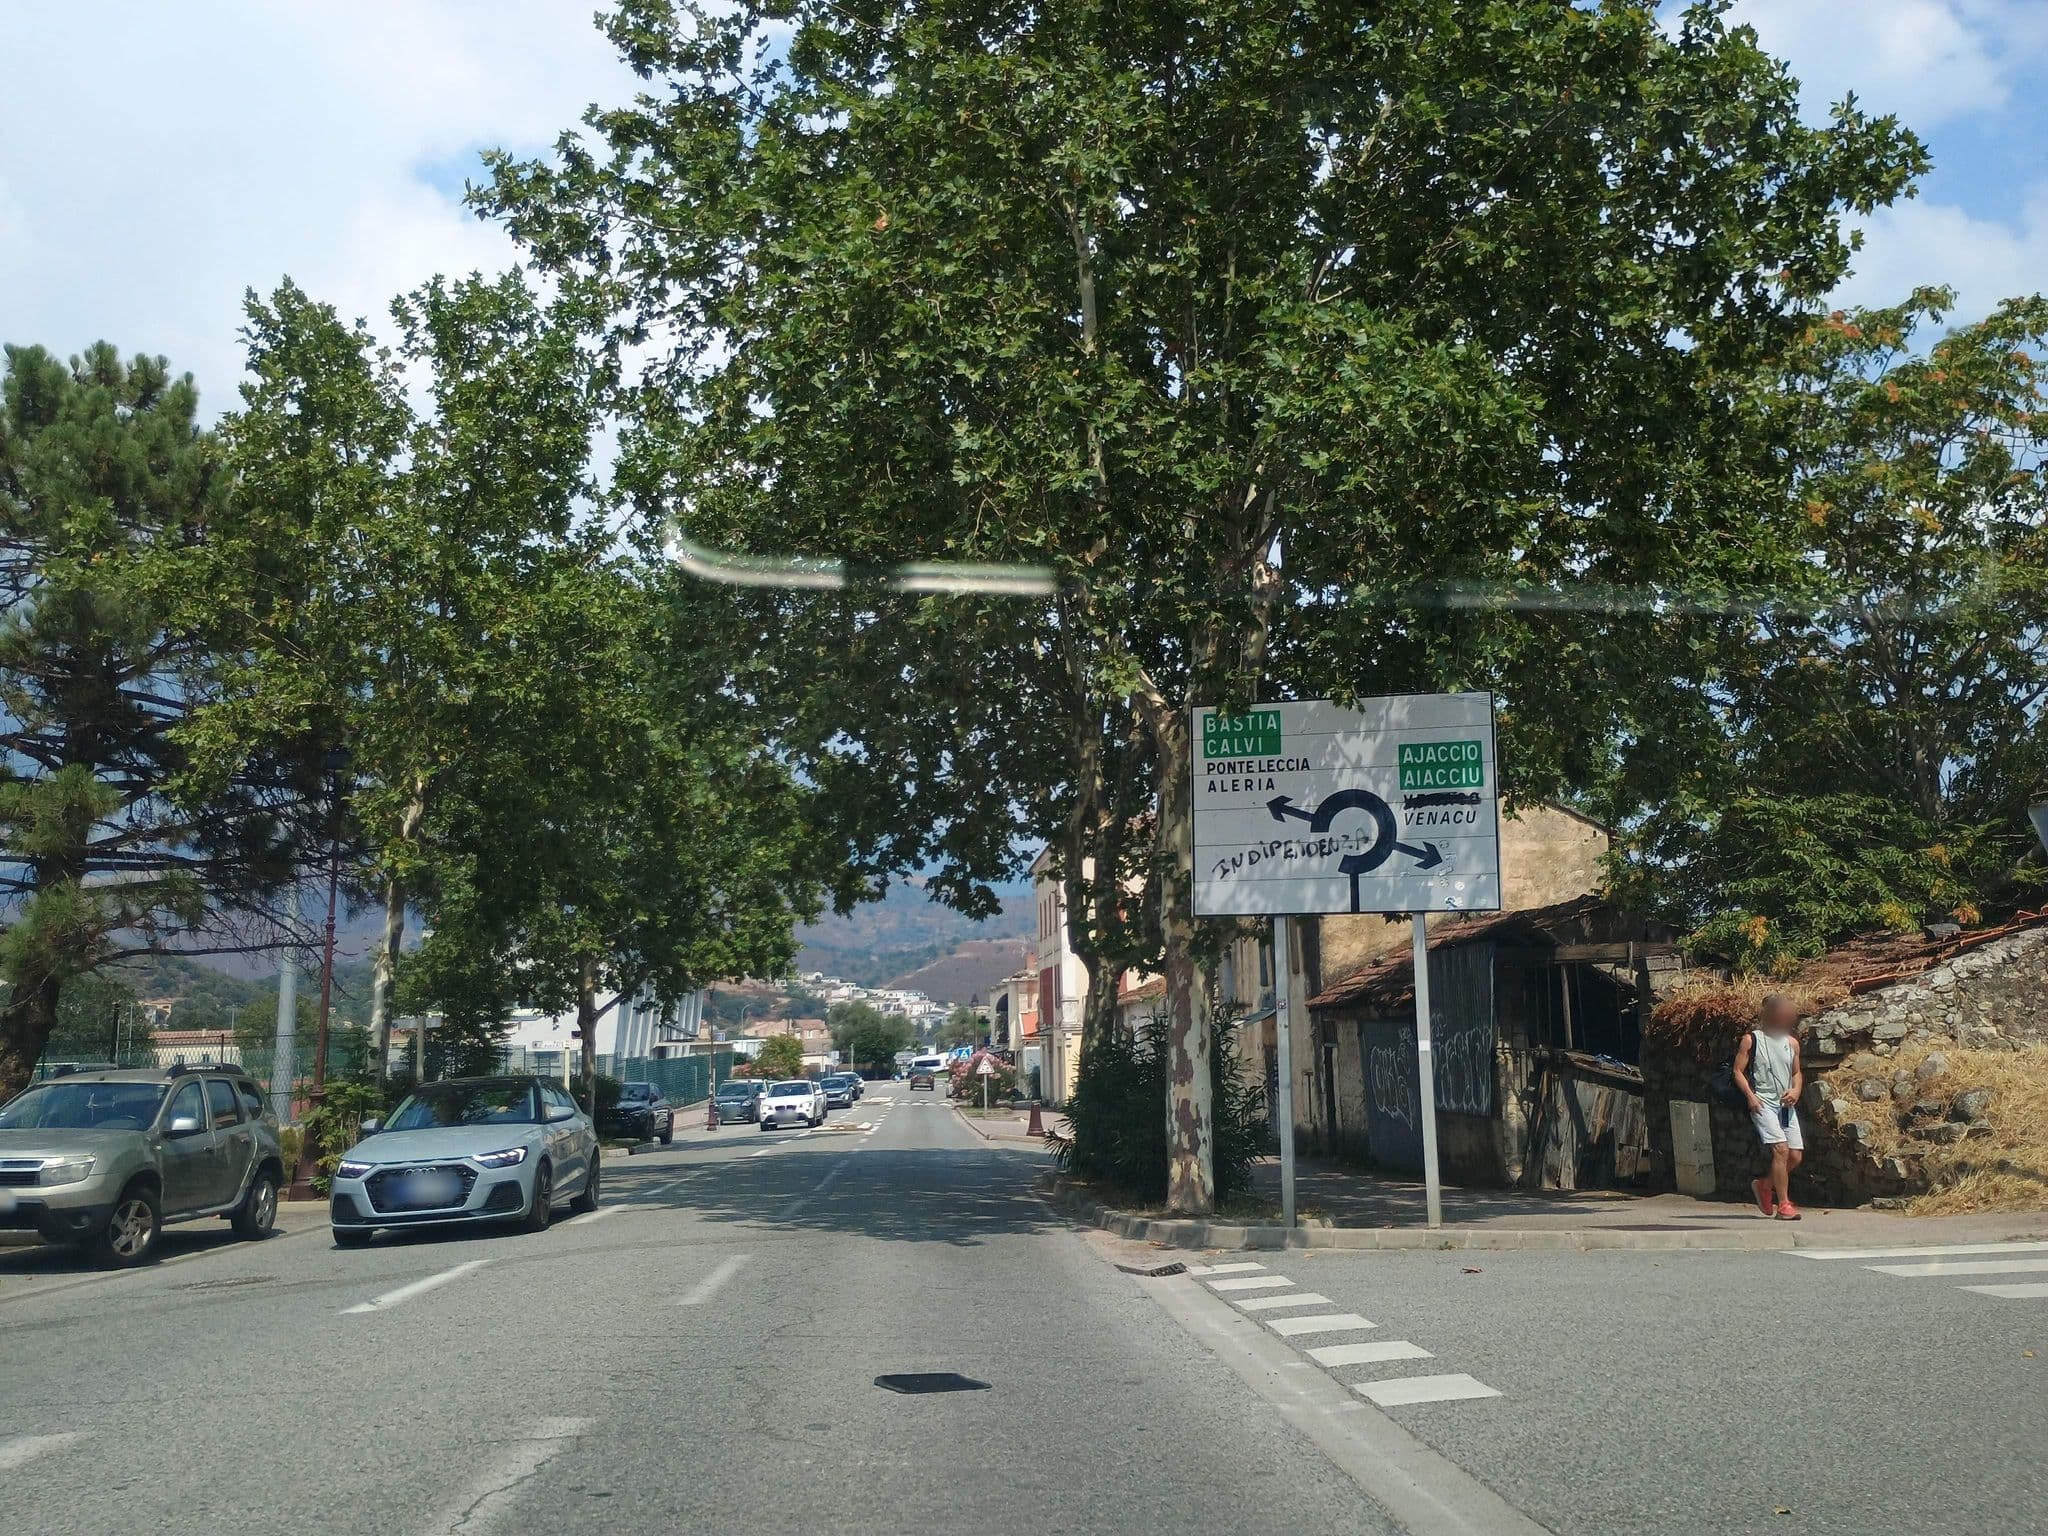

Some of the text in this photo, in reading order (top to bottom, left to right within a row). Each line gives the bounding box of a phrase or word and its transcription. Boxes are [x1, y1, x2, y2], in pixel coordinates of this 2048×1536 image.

[1206, 714, 1277, 733] BASTIA
[1207, 737, 1262, 755] CALVI
[1403, 744, 1478, 763] AJACCIO
[1207, 758, 1310, 775] PONTE LECCIA
[1208, 778, 1275, 793] ALERIA
[1404, 767, 1480, 787] AIACCIU
[1404, 810, 1477, 825] VENACU
